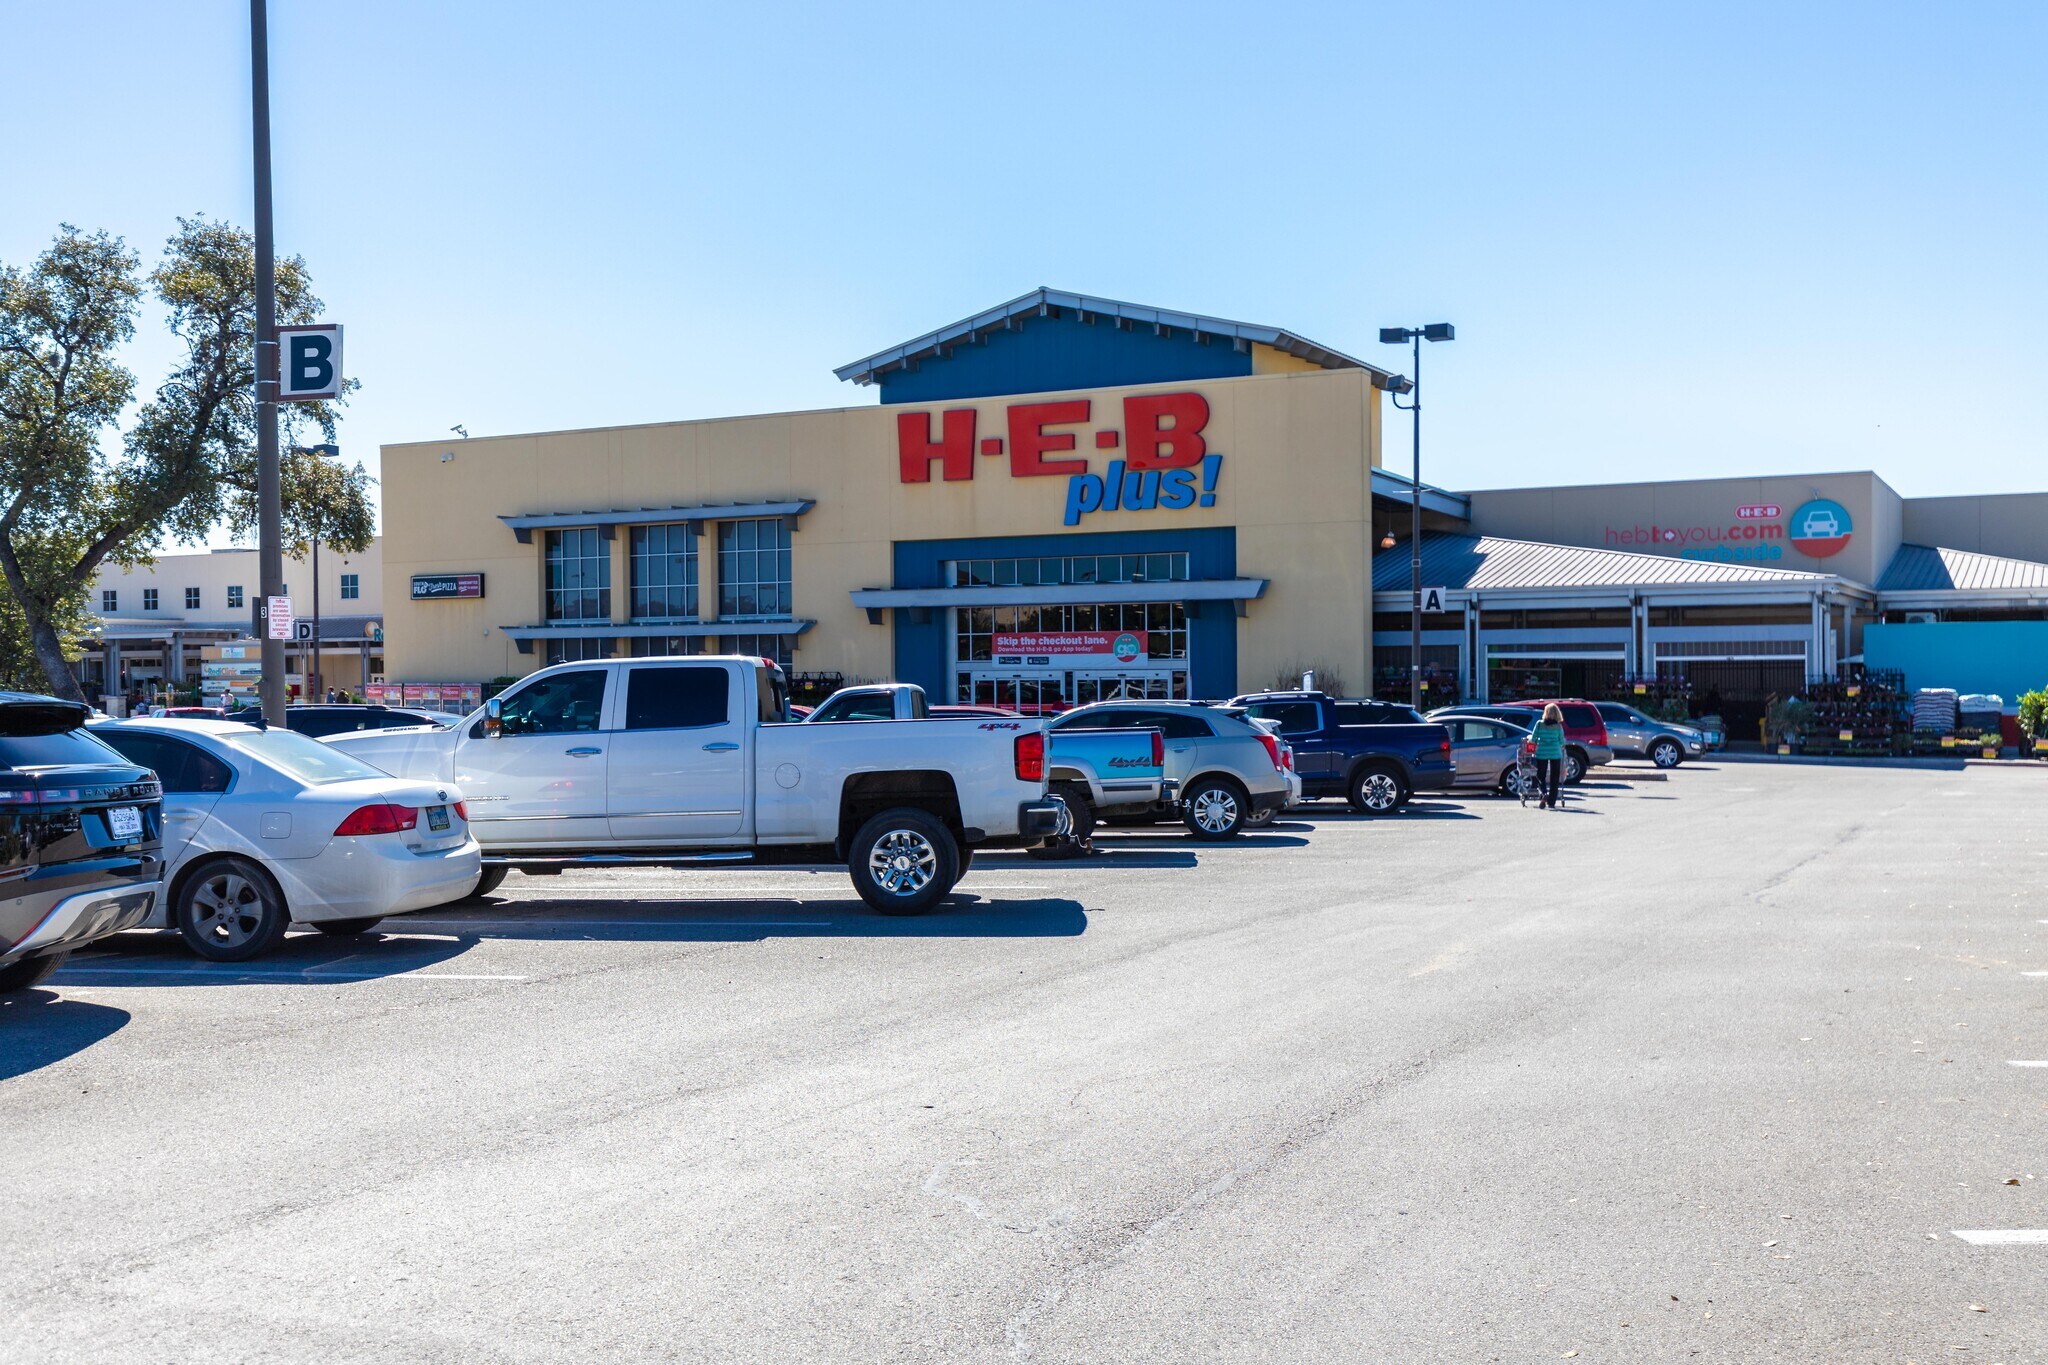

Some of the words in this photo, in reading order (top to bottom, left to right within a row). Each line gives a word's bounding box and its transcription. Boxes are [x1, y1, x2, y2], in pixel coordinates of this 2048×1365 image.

[290, 335, 334, 391] B
[1064, 455, 1223, 526] plus!
[1605, 524, 1782, 546] hebtoyou.com
[442, 582, 457, 591] PIZZA
[1425, 589, 1441, 610] A
[299, 624, 310, 639] D
[997, 636, 1018, 646] Skip
[1021, 636, 1036, 645] the
[1038, 636, 1082, 645] checkout
[1084, 636, 1108, 644] lane.
[978, 722, 1021, 731] 4x4
[1108, 756, 1151, 768] 4x4
[84, 786, 129, 796] RANGE
